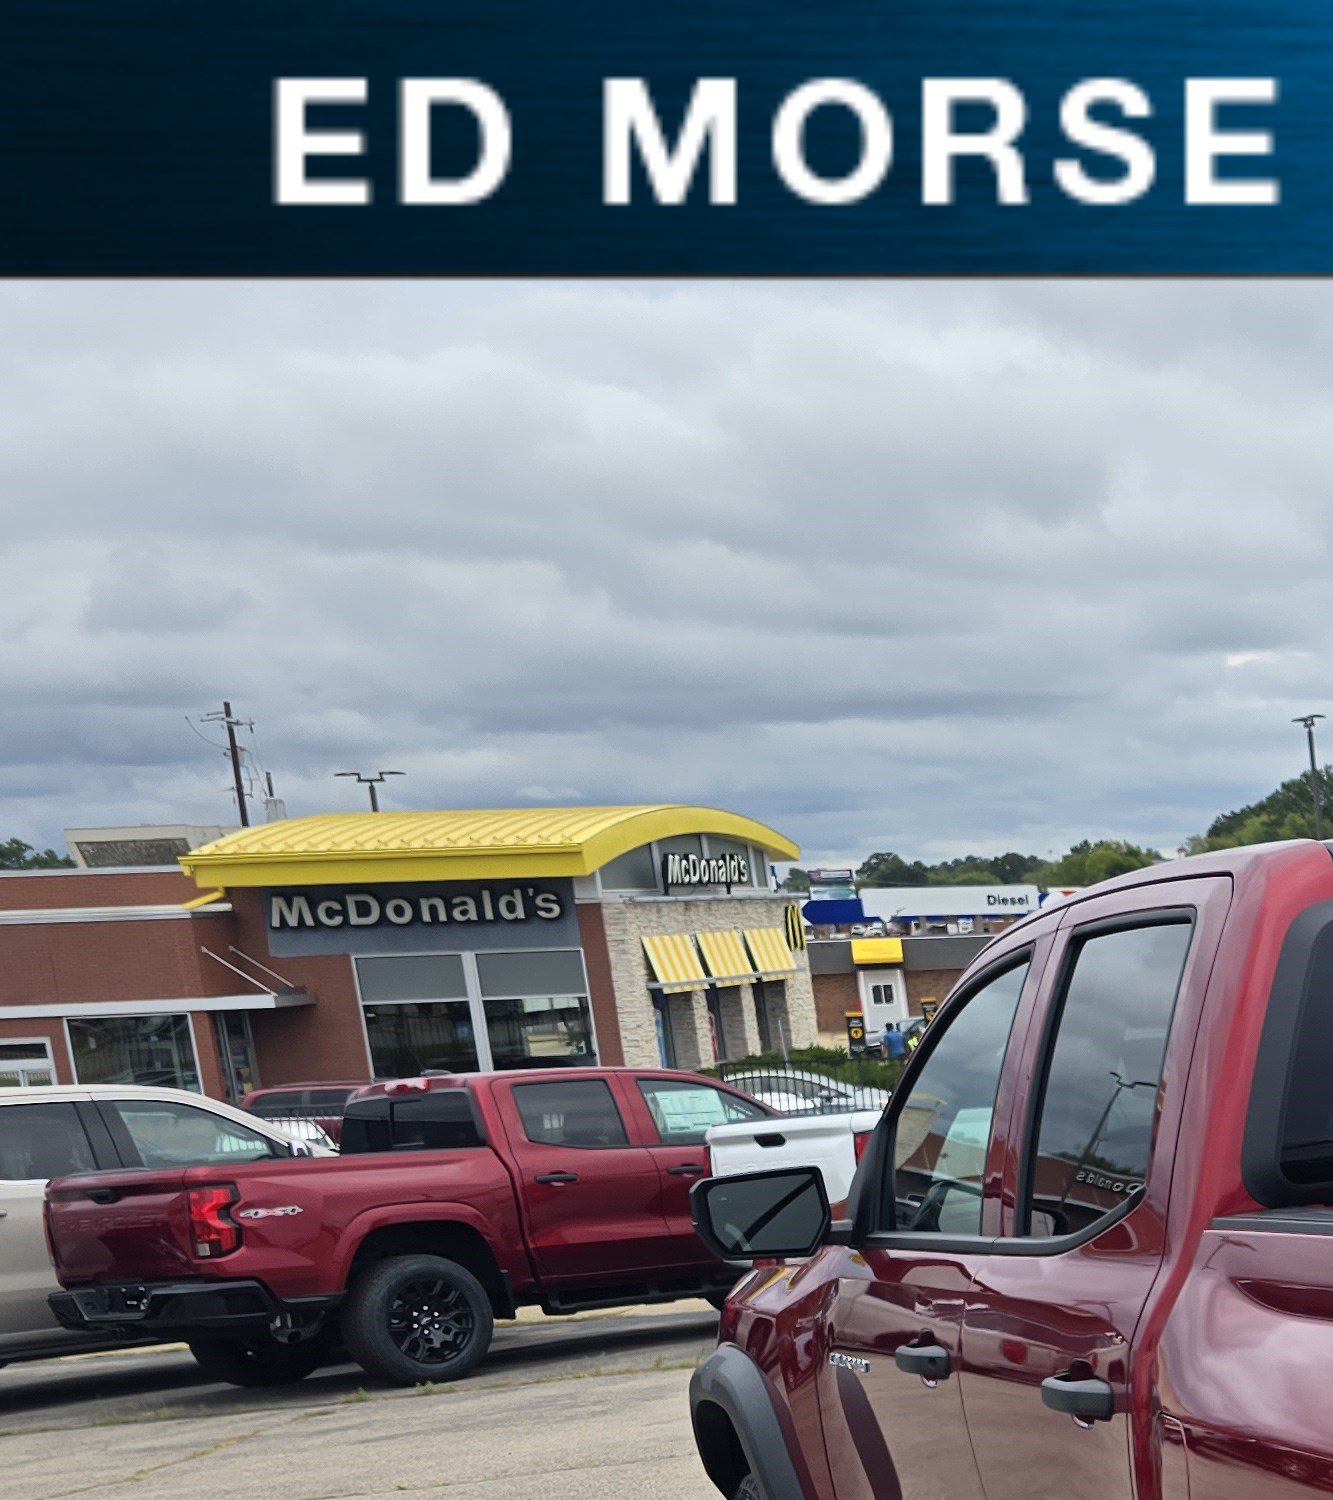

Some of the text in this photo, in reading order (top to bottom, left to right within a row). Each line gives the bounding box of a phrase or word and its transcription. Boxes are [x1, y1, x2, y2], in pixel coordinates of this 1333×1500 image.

[670, 852, 748, 886] McDonald's
[269, 887, 563, 931] McDonald's
[986, 894, 1030, 906] Diesel
